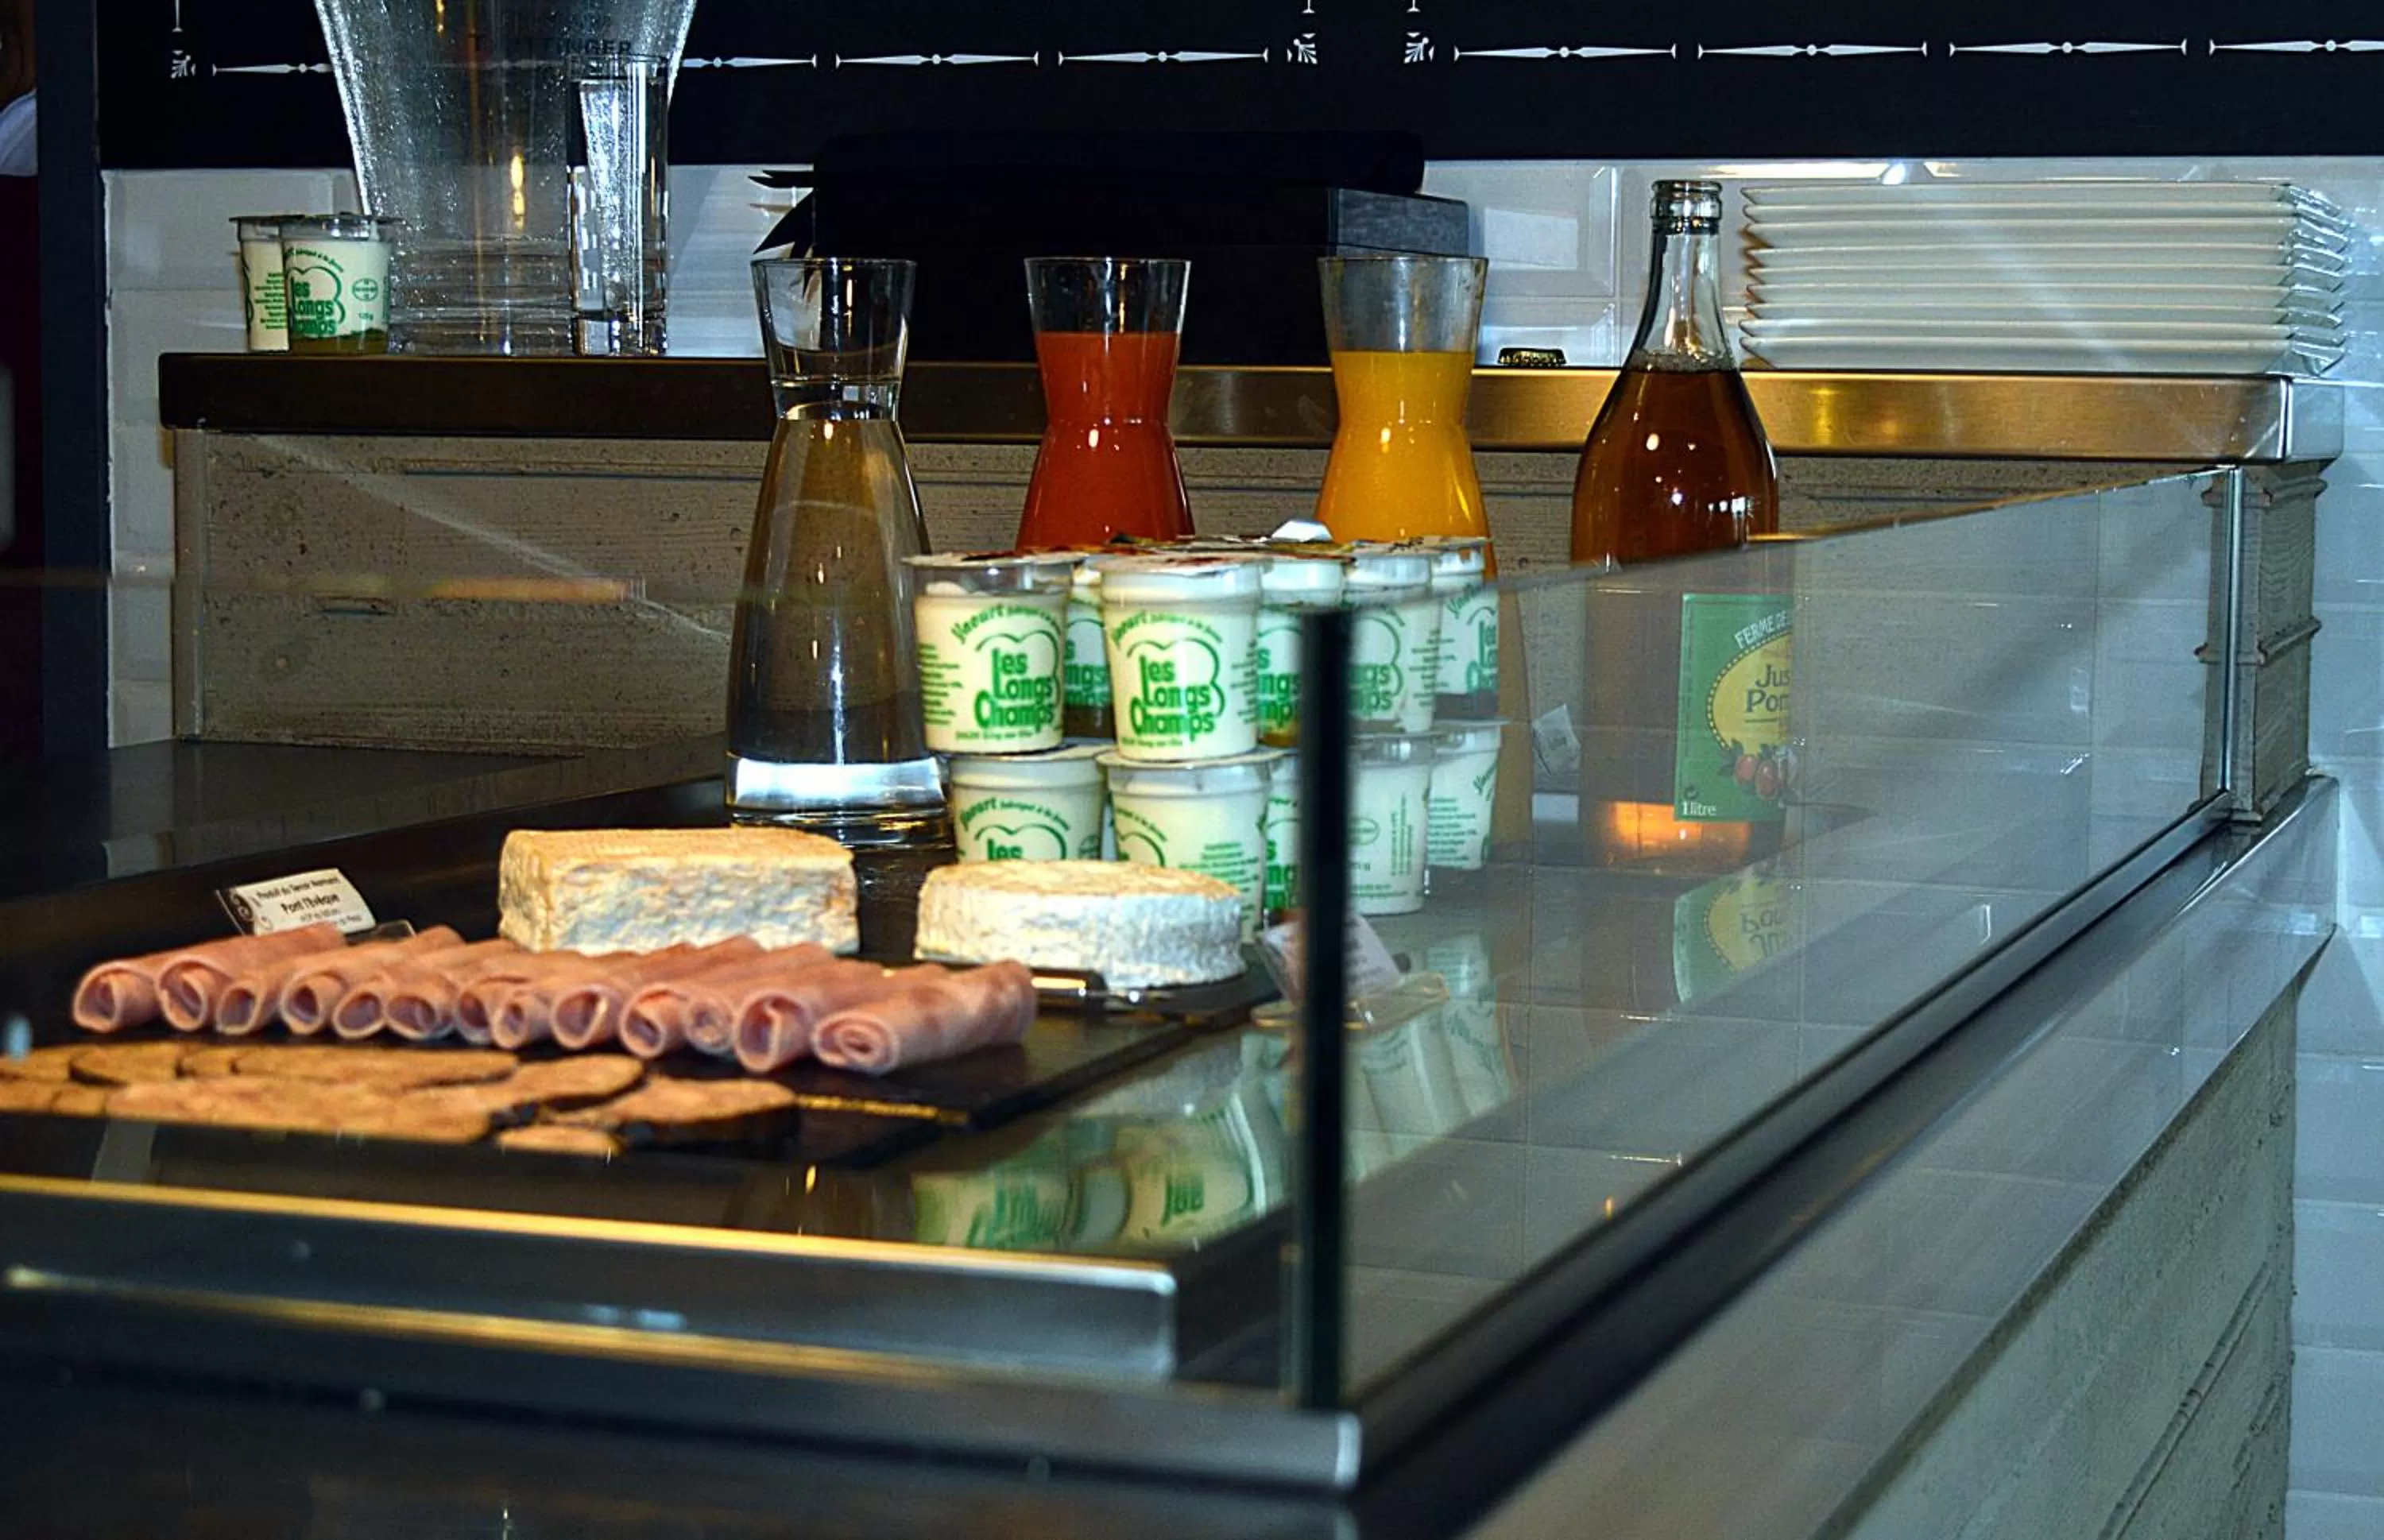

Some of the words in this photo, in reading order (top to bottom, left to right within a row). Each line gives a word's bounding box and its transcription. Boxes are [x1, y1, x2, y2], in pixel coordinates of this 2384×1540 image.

[1734, 614, 1775, 649] FERME
[991, 647, 1028, 675] Les
[1140, 654, 1175, 683] Les
[993, 675, 1054, 704] Longs
[1142, 684, 1212, 715] Longs
[974, 689, 1055, 733] Champs
[1129, 696, 1216, 743] Champs
